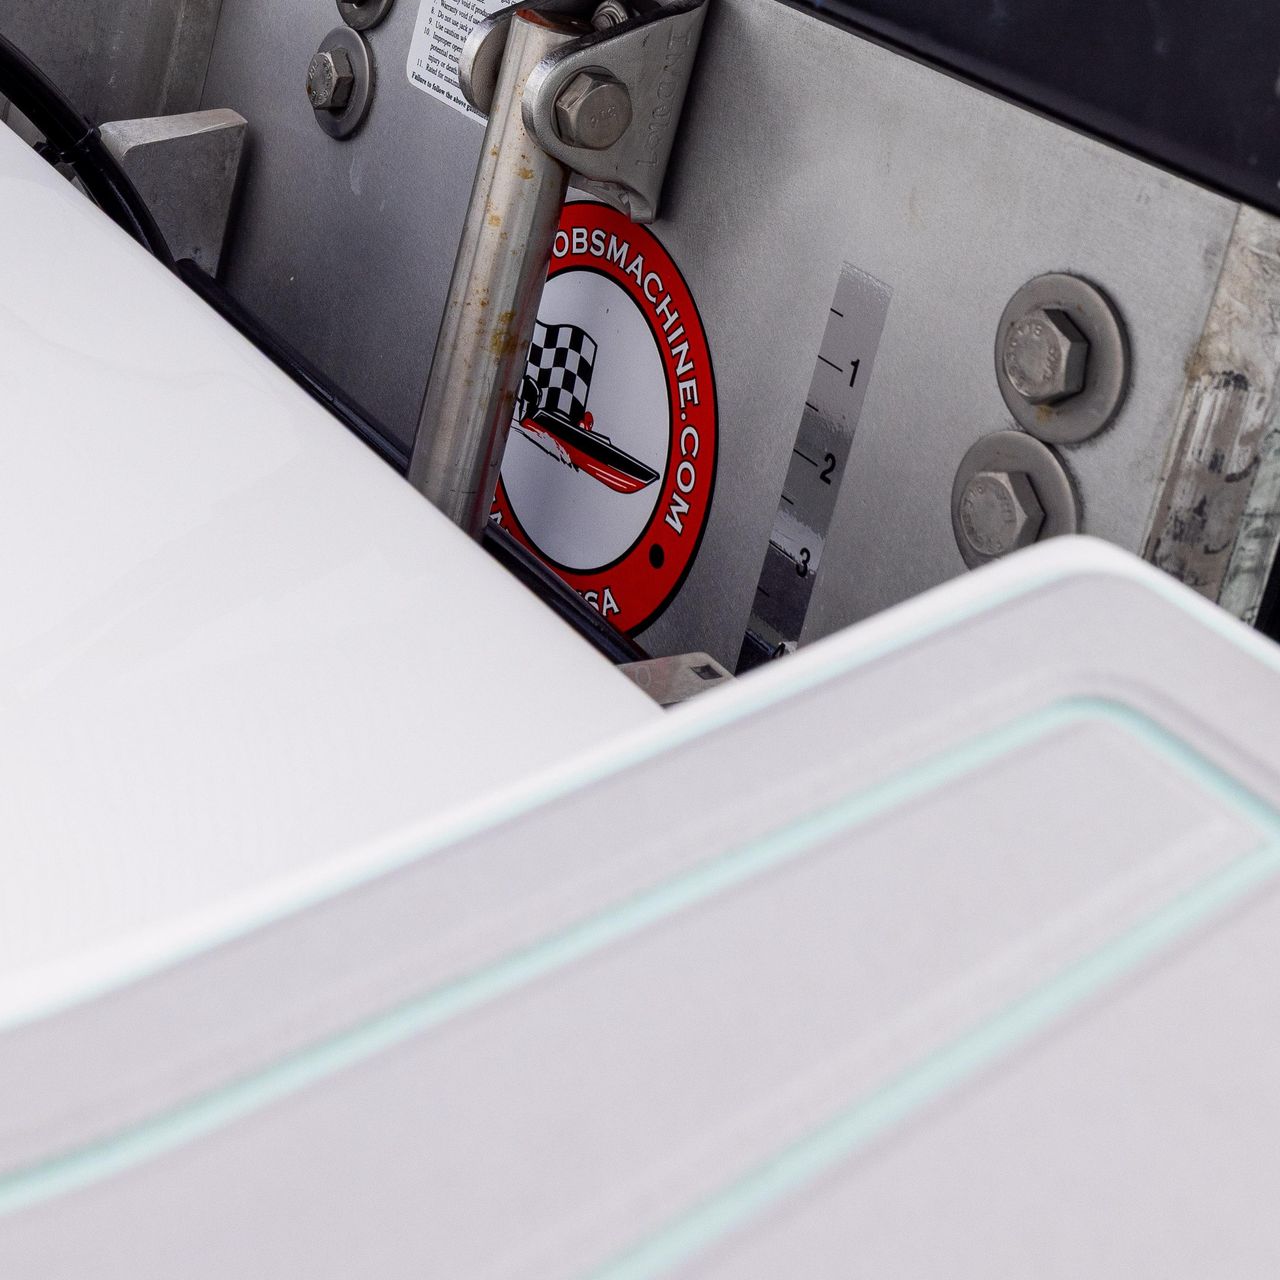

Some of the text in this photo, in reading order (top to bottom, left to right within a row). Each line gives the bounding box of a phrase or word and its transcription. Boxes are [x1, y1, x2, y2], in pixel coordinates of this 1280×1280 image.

[440, 0, 458, 16] Warranty
[444, 27, 460, 40] caution
[425, 63, 438, 76] Rated
[411, 71, 427, 85] Failure
[431, 83, 445, 95] follow
[453, 96, 466, 108] above
[552, 227, 699, 534] OBSMACHINE.COM
[849, 358, 860, 388] 1
[819, 452, 836, 485] 2
[796, 547, 811, 578] 3
[577, 587, 620, 617] SA
